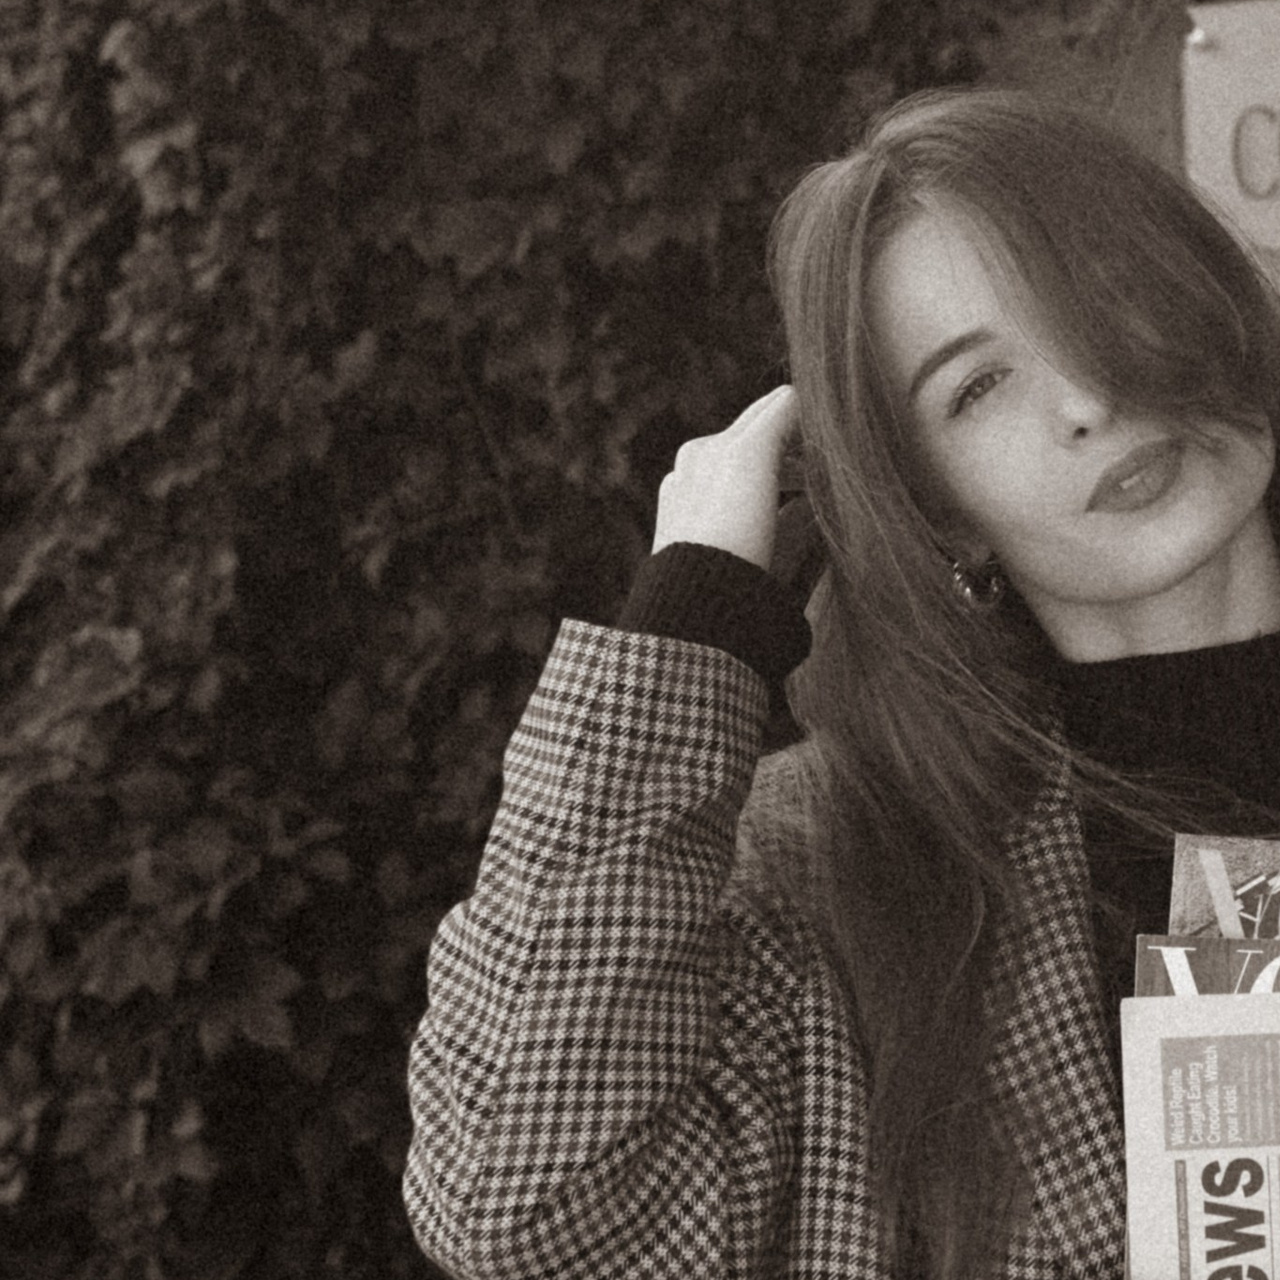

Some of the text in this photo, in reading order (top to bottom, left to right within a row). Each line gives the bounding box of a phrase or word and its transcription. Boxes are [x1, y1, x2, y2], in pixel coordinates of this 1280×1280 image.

[1205, 1045, 1217, 1081] Watch
[1170, 1068, 1185, 1109] Reptile
[1188, 1062, 1205, 1144] Caught Eating
[1170, 1111, 1185, 1145] Weird
[1227, 1117, 1242, 1143] your
